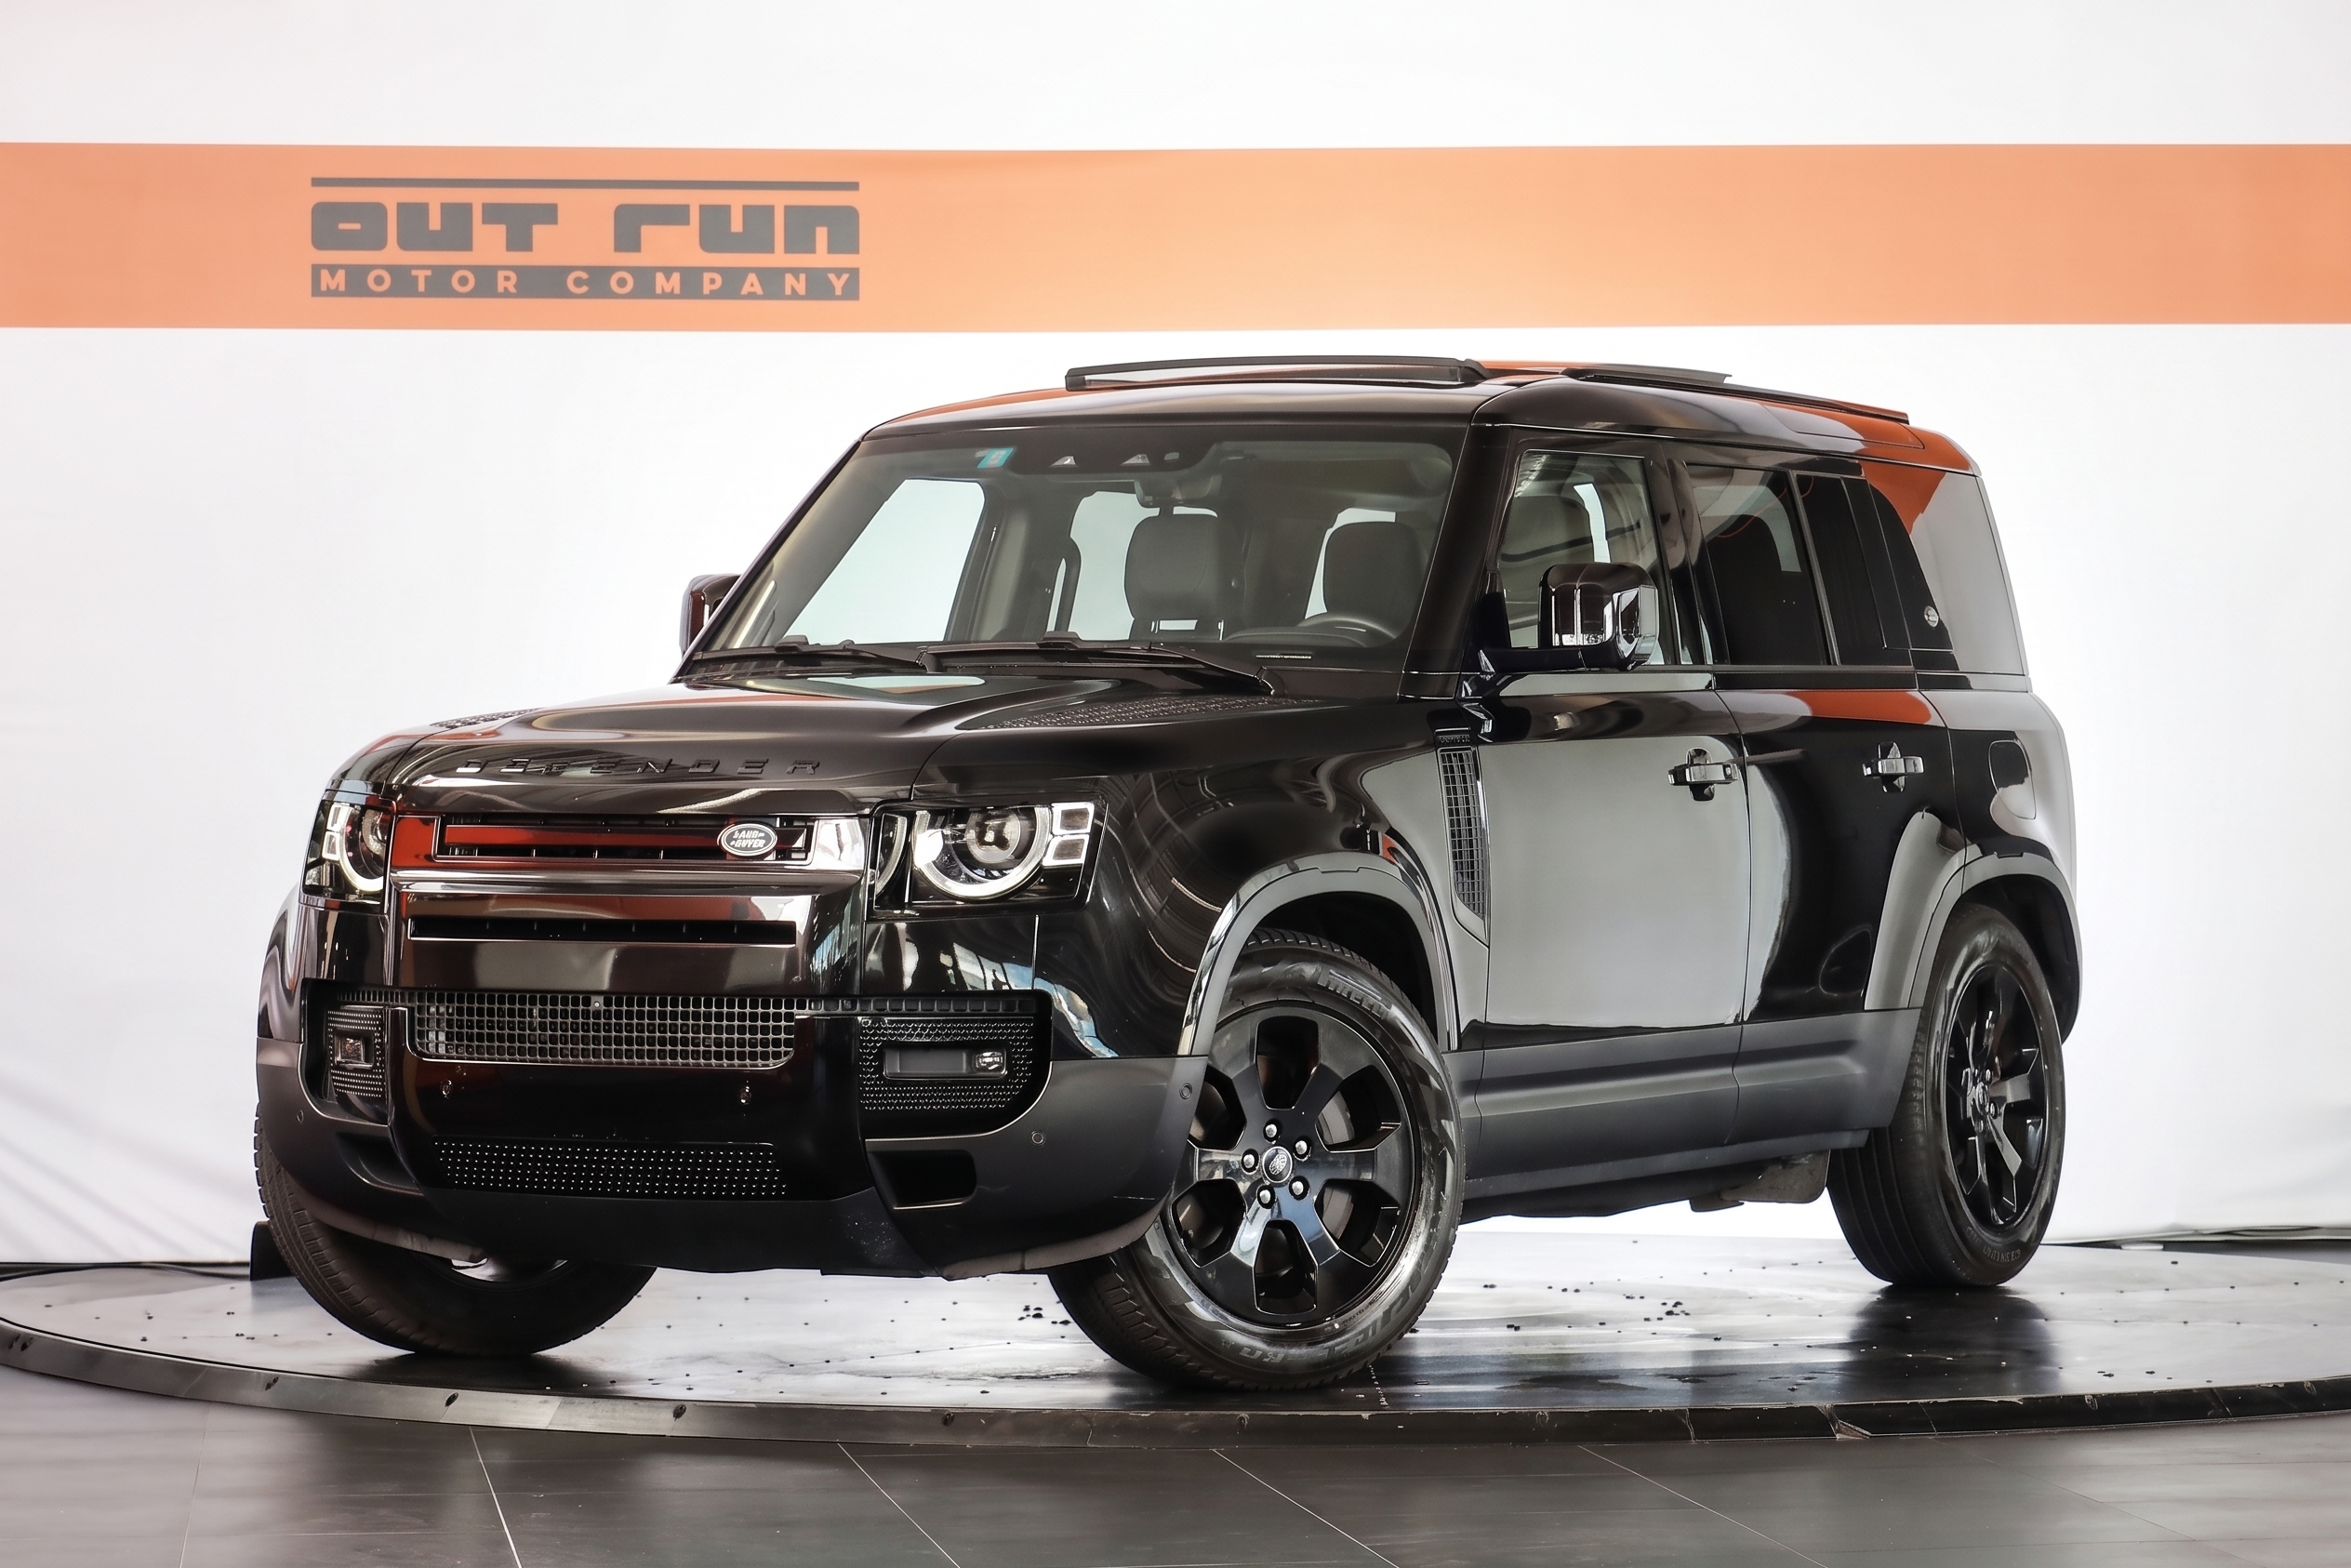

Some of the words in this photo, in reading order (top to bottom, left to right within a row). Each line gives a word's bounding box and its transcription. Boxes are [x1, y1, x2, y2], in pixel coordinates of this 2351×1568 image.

[311, 201, 559, 253] OUT
[320, 268, 518, 294] MOTOR
[566, 270, 850, 297] COMPANY
